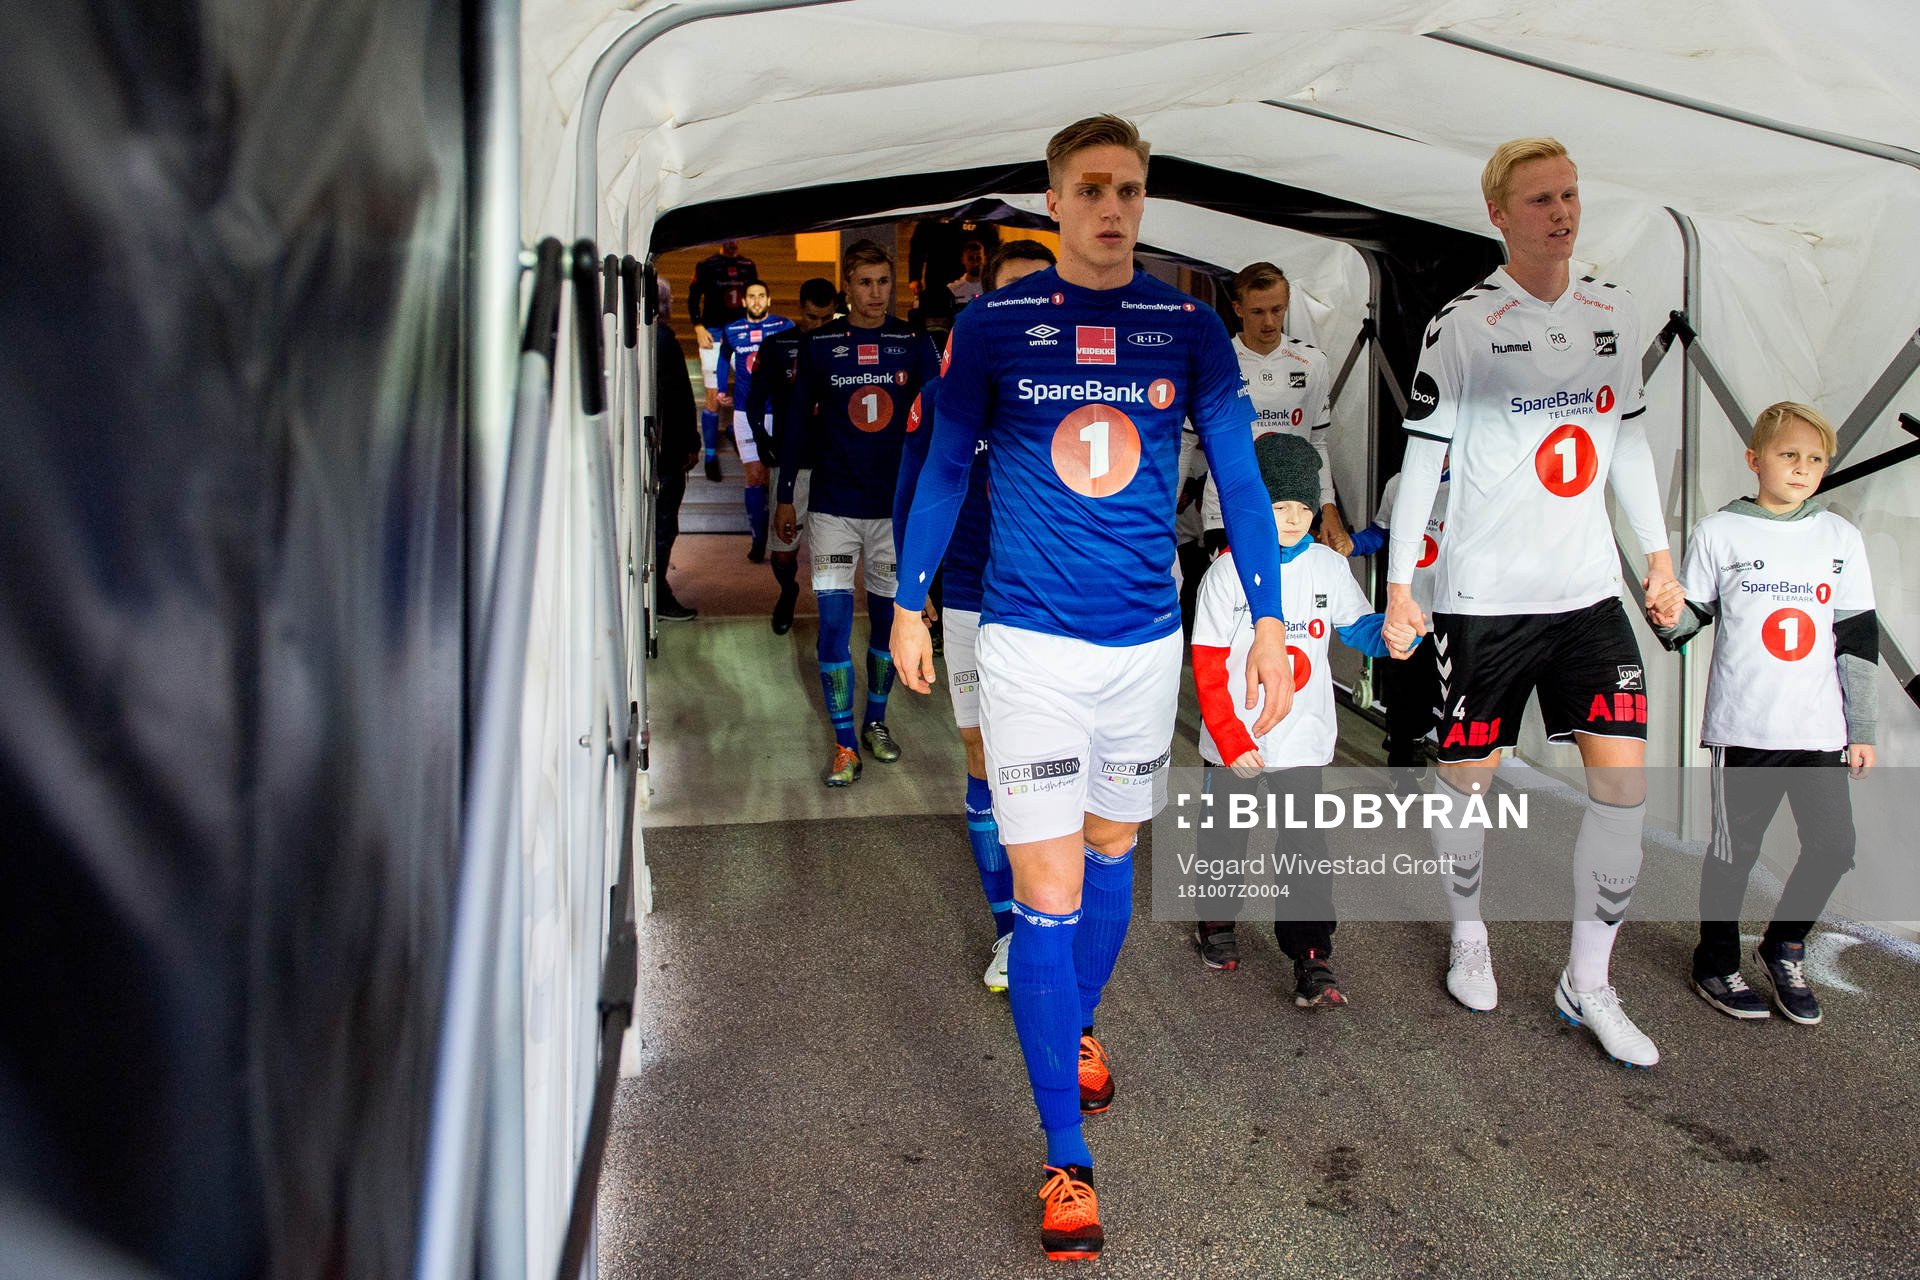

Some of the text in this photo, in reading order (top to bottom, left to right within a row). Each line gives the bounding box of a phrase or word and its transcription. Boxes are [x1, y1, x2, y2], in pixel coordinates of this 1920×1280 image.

[1491, 341, 1532, 354] hummel
[1550, 333, 1567, 344] R8
[831, 373, 893, 387] SpareBank
[1018, 379, 1144, 404] SpareBank
[861, 394, 877, 423] 1
[1511, 388, 1594, 415] SpareBank
[1079, 422, 1110, 479] 1
[1554, 437, 1577, 484] 1
[1741, 581, 1814, 595] SpareBank
[1772, 594, 1814, 602] TELEMARK
[1778, 617, 1799, 652] 1
[1452, 695, 1466, 720] 4
